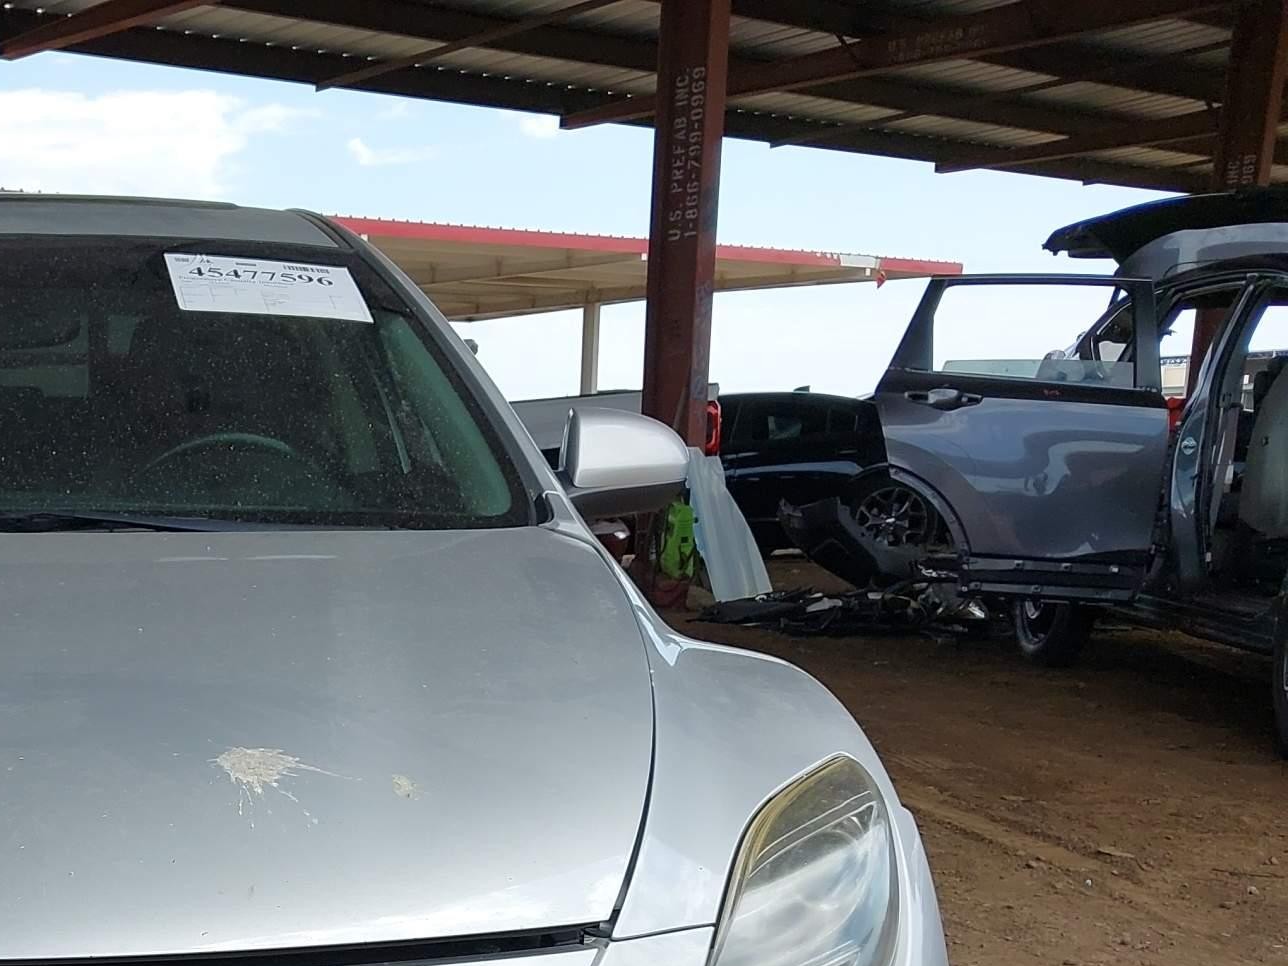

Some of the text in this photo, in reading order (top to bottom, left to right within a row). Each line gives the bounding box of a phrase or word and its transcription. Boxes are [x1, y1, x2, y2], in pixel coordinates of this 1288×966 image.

[667, 67, 690, 242] U.S. PREFAB INC.
[683, 65, 706, 238] 1-866-799-0969
[188, 265, 334, 288] 45477596
